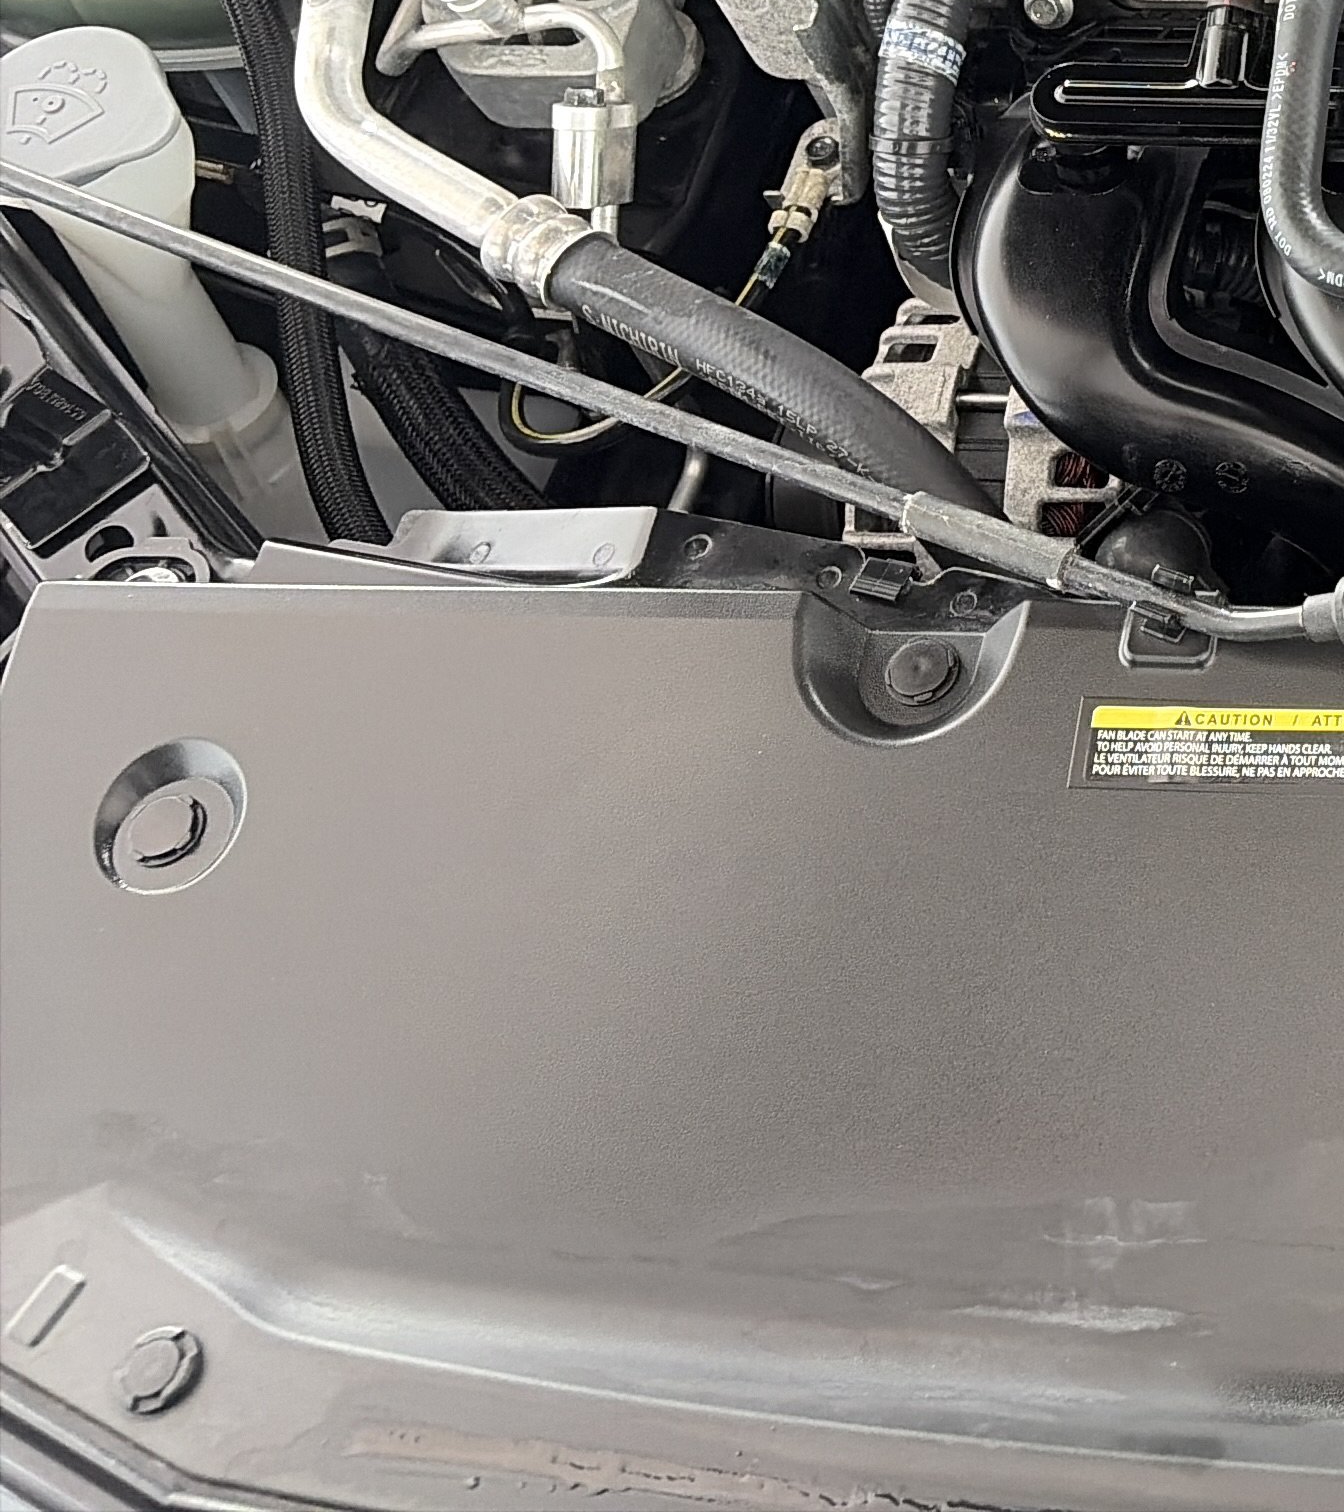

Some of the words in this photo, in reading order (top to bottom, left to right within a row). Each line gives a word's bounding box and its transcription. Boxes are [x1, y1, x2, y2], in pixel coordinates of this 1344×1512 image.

[1274, 229, 1292, 257] DOT
[1195, 713, 1273, 726] CAUTION
[1097, 730, 1117, 740] FAN
[1118, 730, 1147, 740] BLADE
[1147, 731, 1167, 741] CAN
[1168, 731, 1198, 741] START
[1198, 731, 1209, 741] AT
[1209, 732, 1230, 742] ANY
[1230, 732, 1253, 742] TIME.
[1096, 741, 1110, 751] TO
[1110, 742, 1134, 752] HELP
[1134, 742, 1162, 752] AVOID
[1163, 742, 1210, 753] PERSONAL
[1244, 744, 1267, 754] KEEP
[1268, 744, 1301, 754] HANDS
[1094, 753, 1107, 763] LE
[1107, 753, 1171, 764] VENTILATEUR
[1171, 754, 1209, 765] RISQUE
[1210, 754, 1224, 764] DE
[1225, 753, 1281, 765] DÉMARRER
[1290, 755, 1317, 765] TOUT
[1092, 765, 1121, 775] POUR
[1122, 764, 1156, 776] ÉVITER
[1157, 765, 1188, 775] TOUTE
[1189, 766, 1241, 778] BLESSURE,
[1241, 767, 1256, 777] NE
[1257, 767, 1275, 777] PAS
[1277, 767, 1292, 777] EN
